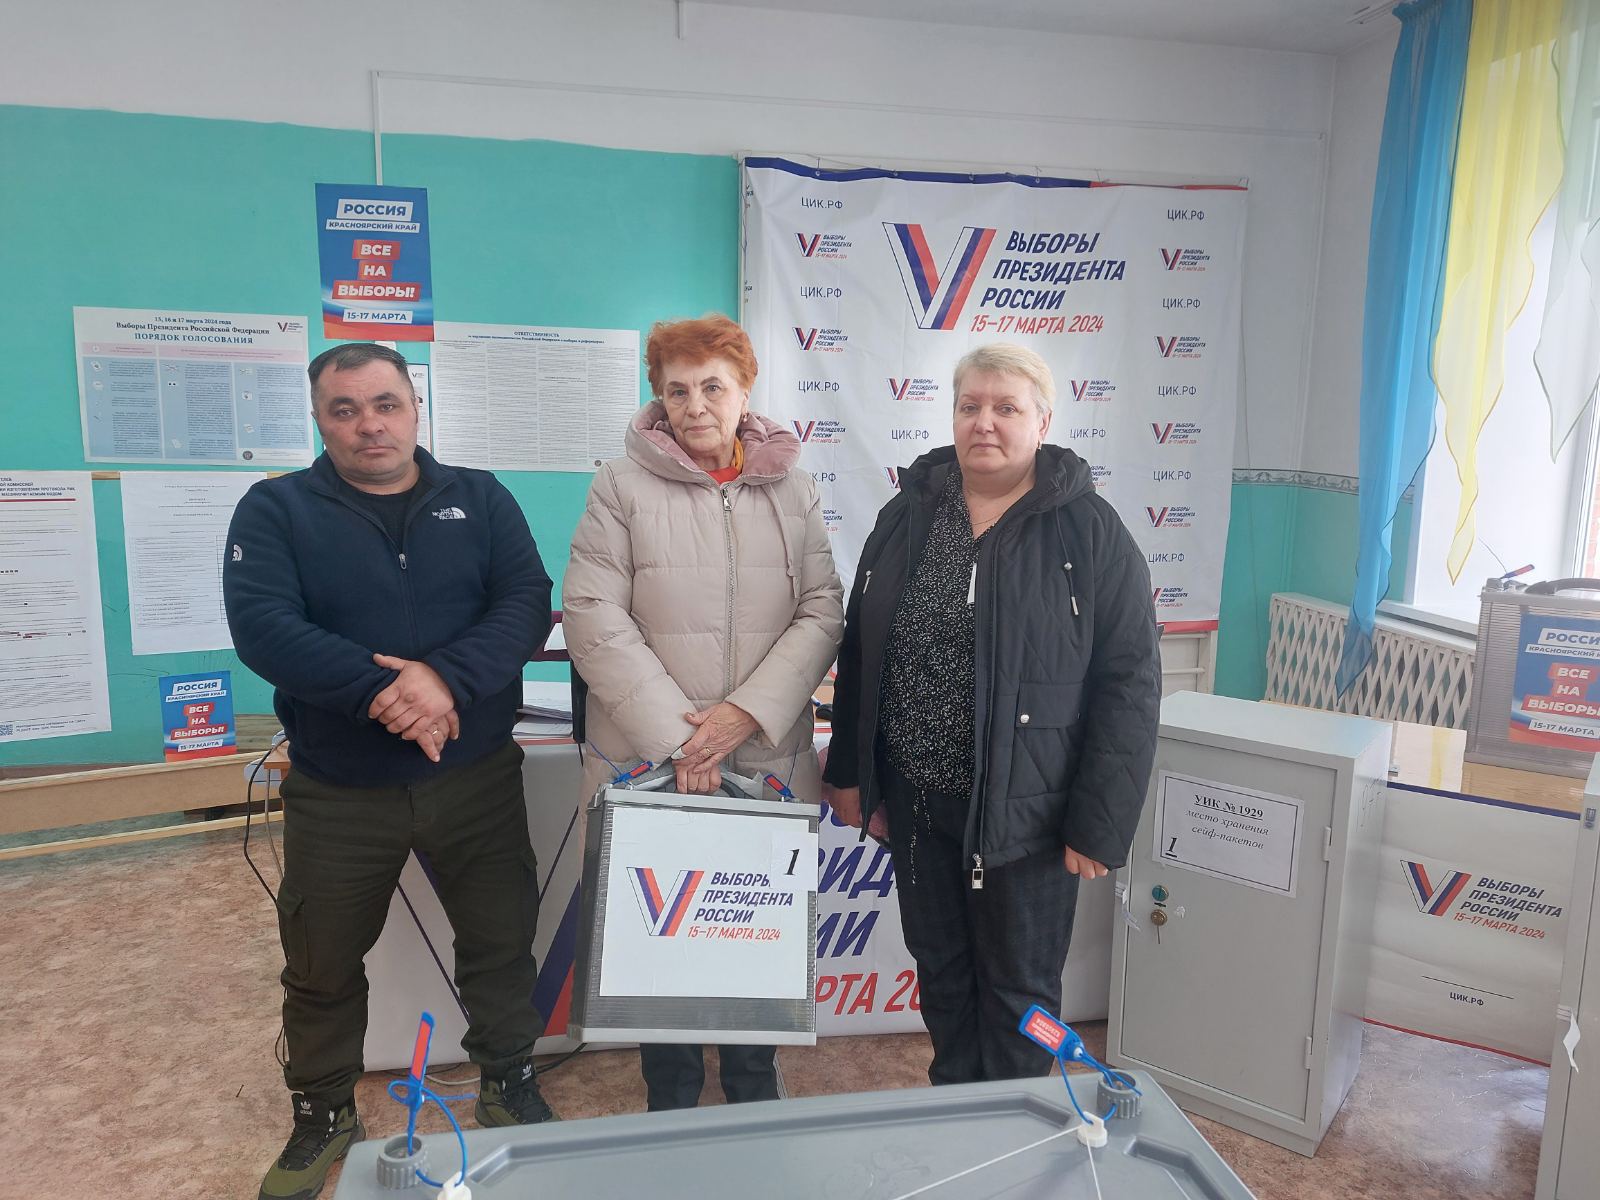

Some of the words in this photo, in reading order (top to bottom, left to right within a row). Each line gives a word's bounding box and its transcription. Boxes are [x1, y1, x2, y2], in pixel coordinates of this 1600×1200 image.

[801, 197, 843, 209] ЦИК.РФ
[344, 204, 406, 216] РОССИЯ
[1167, 209, 1205, 221] ЦИК.РФ
[329, 221, 393, 230] КРАСНОЯРСКИЙ
[1005, 230, 1100, 254] ВЫБОРЫ
[361, 244, 392, 256] ВСЕ
[363, 265, 386, 276] НА
[992, 259, 1126, 285] ПРЕЗИДЕНТА
[338, 284, 415, 298] ВЫБОРЫ!
[800, 286, 842, 298] ЦИК.РФ
[980, 287, 1067, 310] РОССИИ
[1162, 298, 1201, 310] ЦИК.РФ
[372, 312, 407, 321] МАРТА
[116, 322, 146, 331] Выборы
[147, 323, 189, 332] Президента
[190, 325, 230, 333] Российской
[232, 327, 270, 335] Федерации
[1016, 316, 1066, 334] МАРТА
[1067, 315, 1104, 332] 2024
[134, 333, 180, 342] ПОРЯДОК
[182, 334, 253, 344] ГОЛОСОВАНИЯ
[798, 380, 840, 393] ЦИК.РФ
[1158, 386, 1197, 397] ЦИК.РФ
[891, 429, 929, 441] ЦИК.РФ
[1070, 428, 1106, 440] ЦИК.РФ
[809, 472, 836, 482] К.РФ
[1153, 470, 1191, 482] ЦИК.РФ
[1148, 553, 1185, 564] ЦИК.РФ
[1546, 632, 1600, 645] РОССИ
[1529, 646, 1595, 657] КРАСНОЯРСКИЙ
[1558, 667, 1591, 680] ВСЕ
[177, 682, 217, 691] РОССИЯ
[1557, 685, 1580, 696] НА
[189, 705, 209, 713] ВСЕ
[174, 726, 224, 738] ВЫБОРЫ!
[1533, 722, 1556, 731] 15-17
[1558, 726, 1595, 736] МАРТА
[1194, 794, 1221, 809] УИК
[1222, 802, 1236, 812] №
[1239, 805, 1264, 818] 1929
[1186, 810, 1219, 823] место
[1220, 818, 1269, 836] хранения
[1192, 826, 1264, 850] сейф-пакетов
[1168, 837, 1177, 853] 1
[784, 848, 801, 876] 1
[1477, 877, 1544, 899] ВЫБОРЫ
[702, 890, 794, 906] ПРЕЗИДЕНТА
[1468, 890, 1562, 917] ПРЕЗИДЕНТА
[694, 908, 754, 923] РОССИИ
[1460, 901, 1520, 921] РОССИИ
[718, 927, 753, 940] МАРТА
[755, 928, 781, 941] 2024
[1482, 919, 1518, 934] МАРТА
[1519, 927, 1545, 940] 2024
[815, 972, 879, 1016] РТА
[1450, 991, 1484, 1006] ЦИК.РФ
